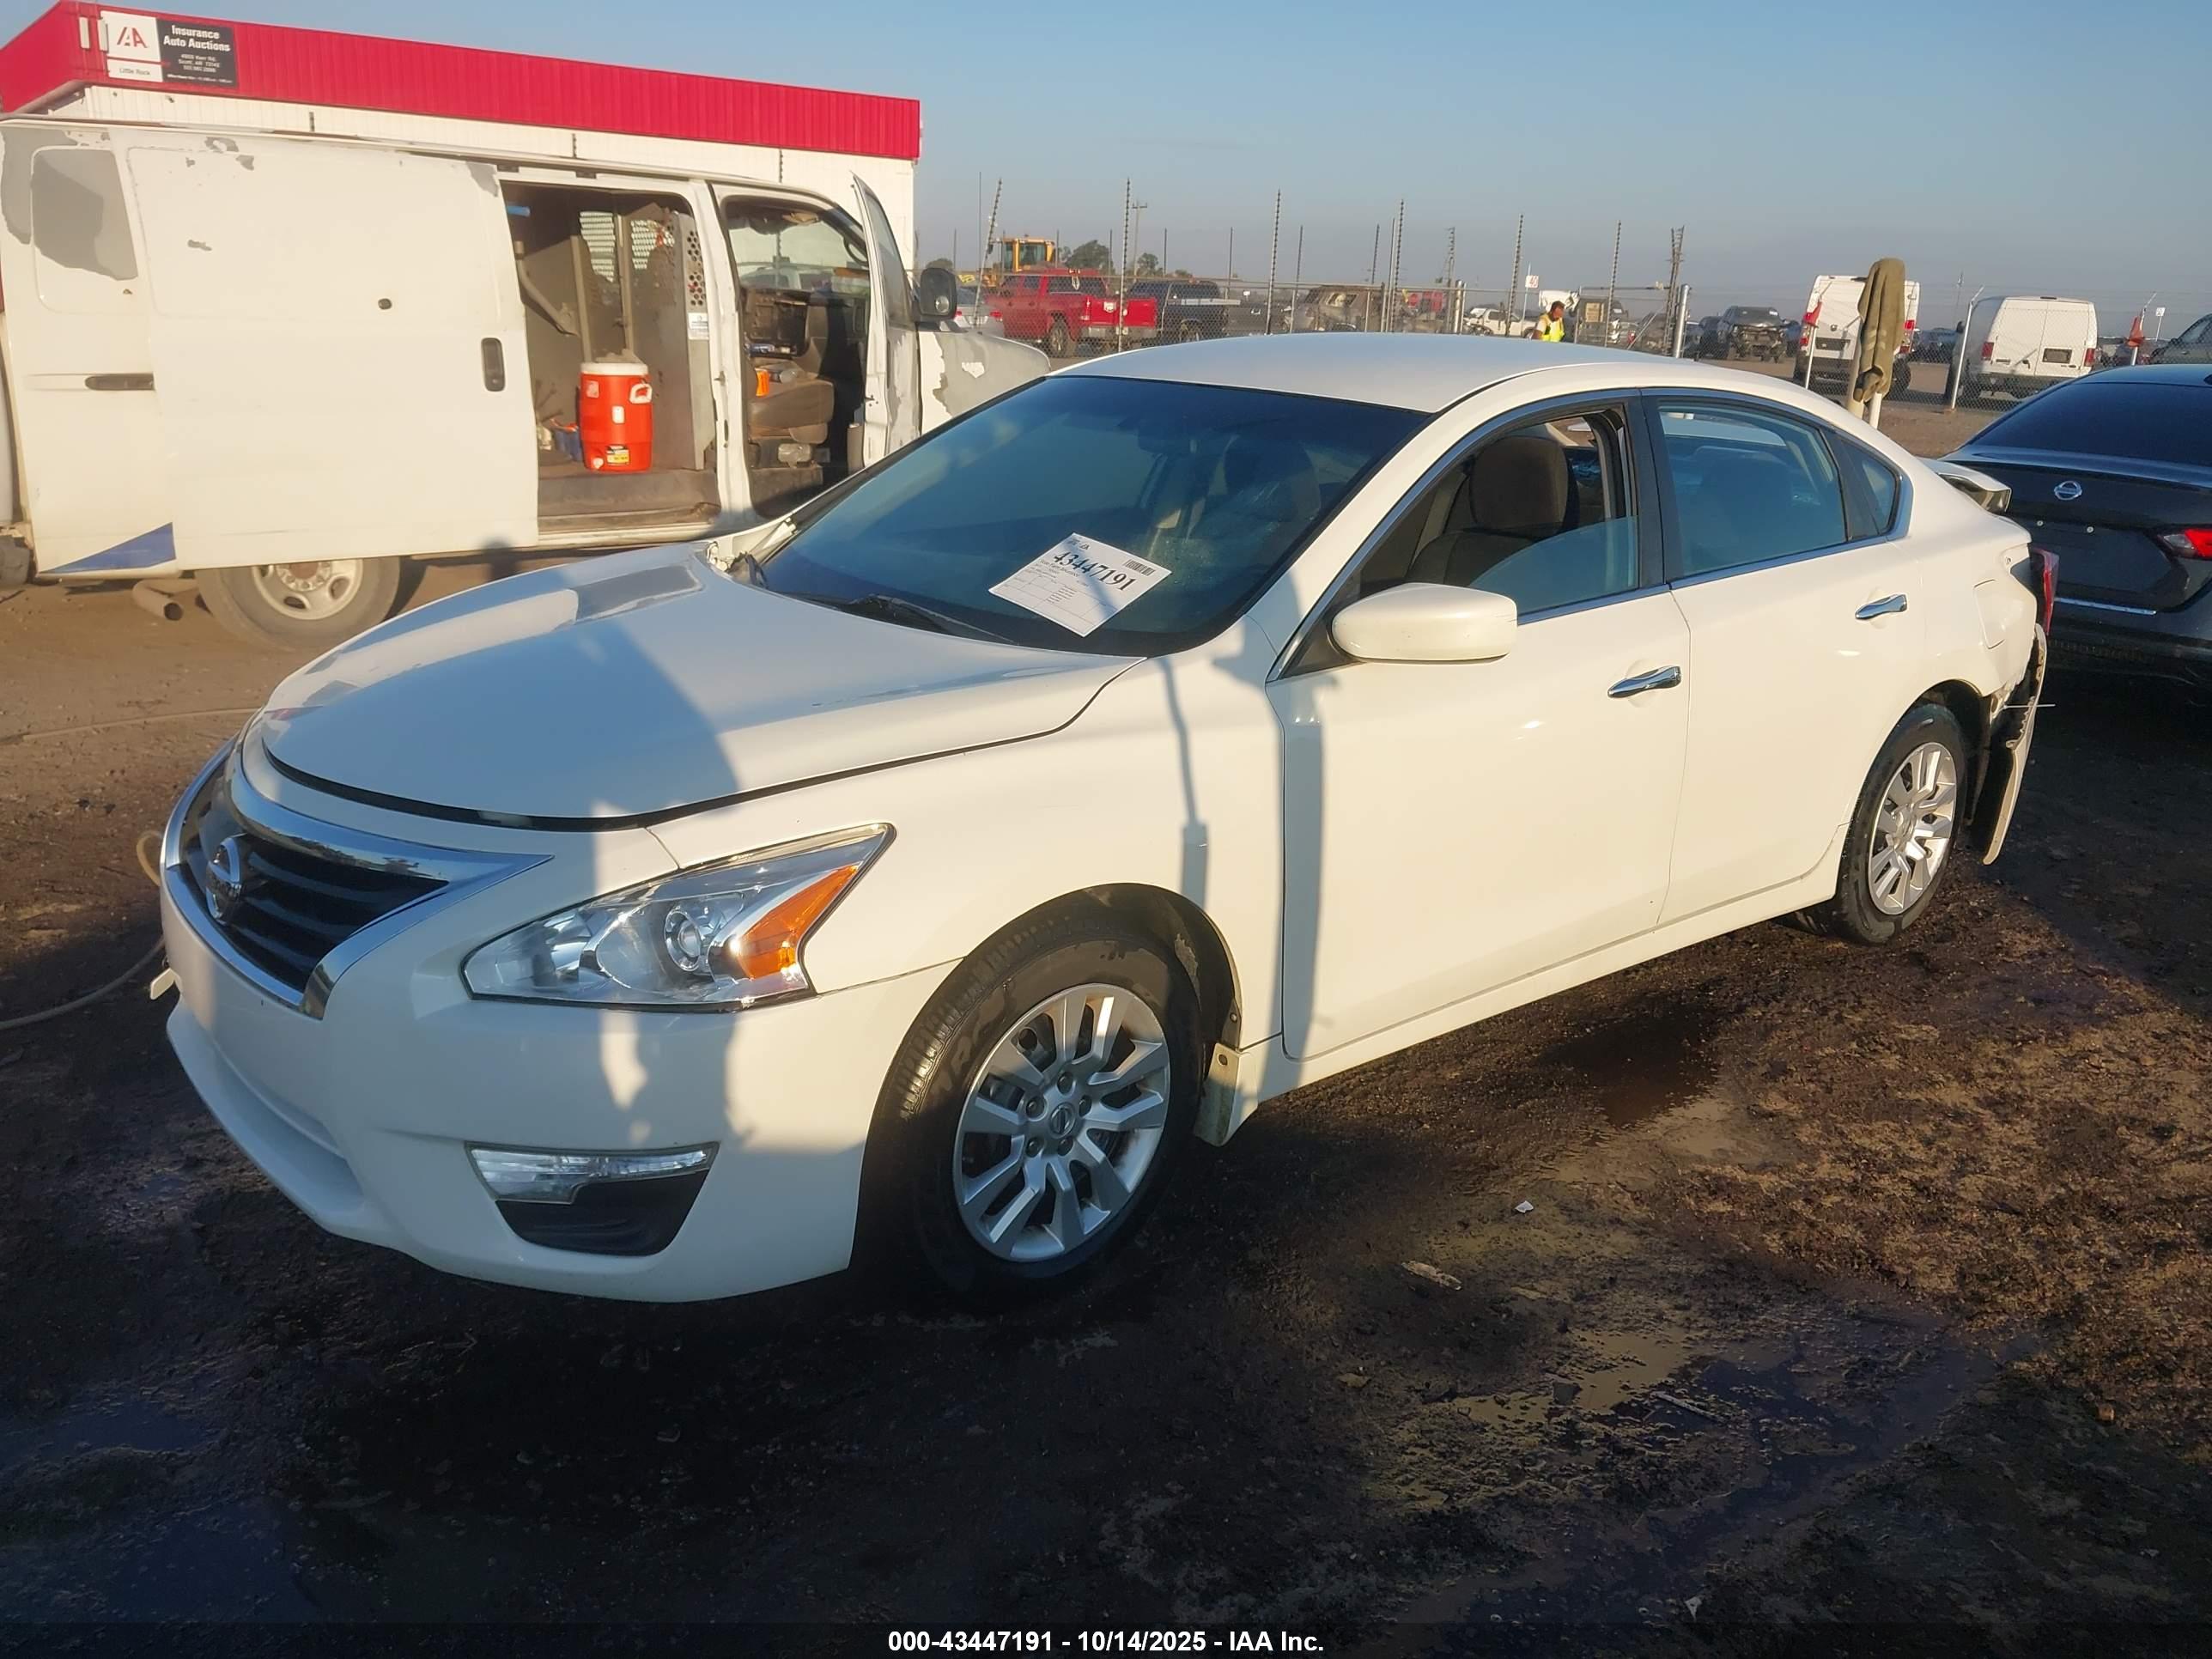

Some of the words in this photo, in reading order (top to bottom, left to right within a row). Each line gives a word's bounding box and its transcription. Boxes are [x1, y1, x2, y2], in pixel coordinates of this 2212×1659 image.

[172, 24, 220, 40] Insurance
[163, 34, 186, 47] Auto
[188, 38, 231, 52] Auctions
[1053, 551, 1137, 591] 43447191
